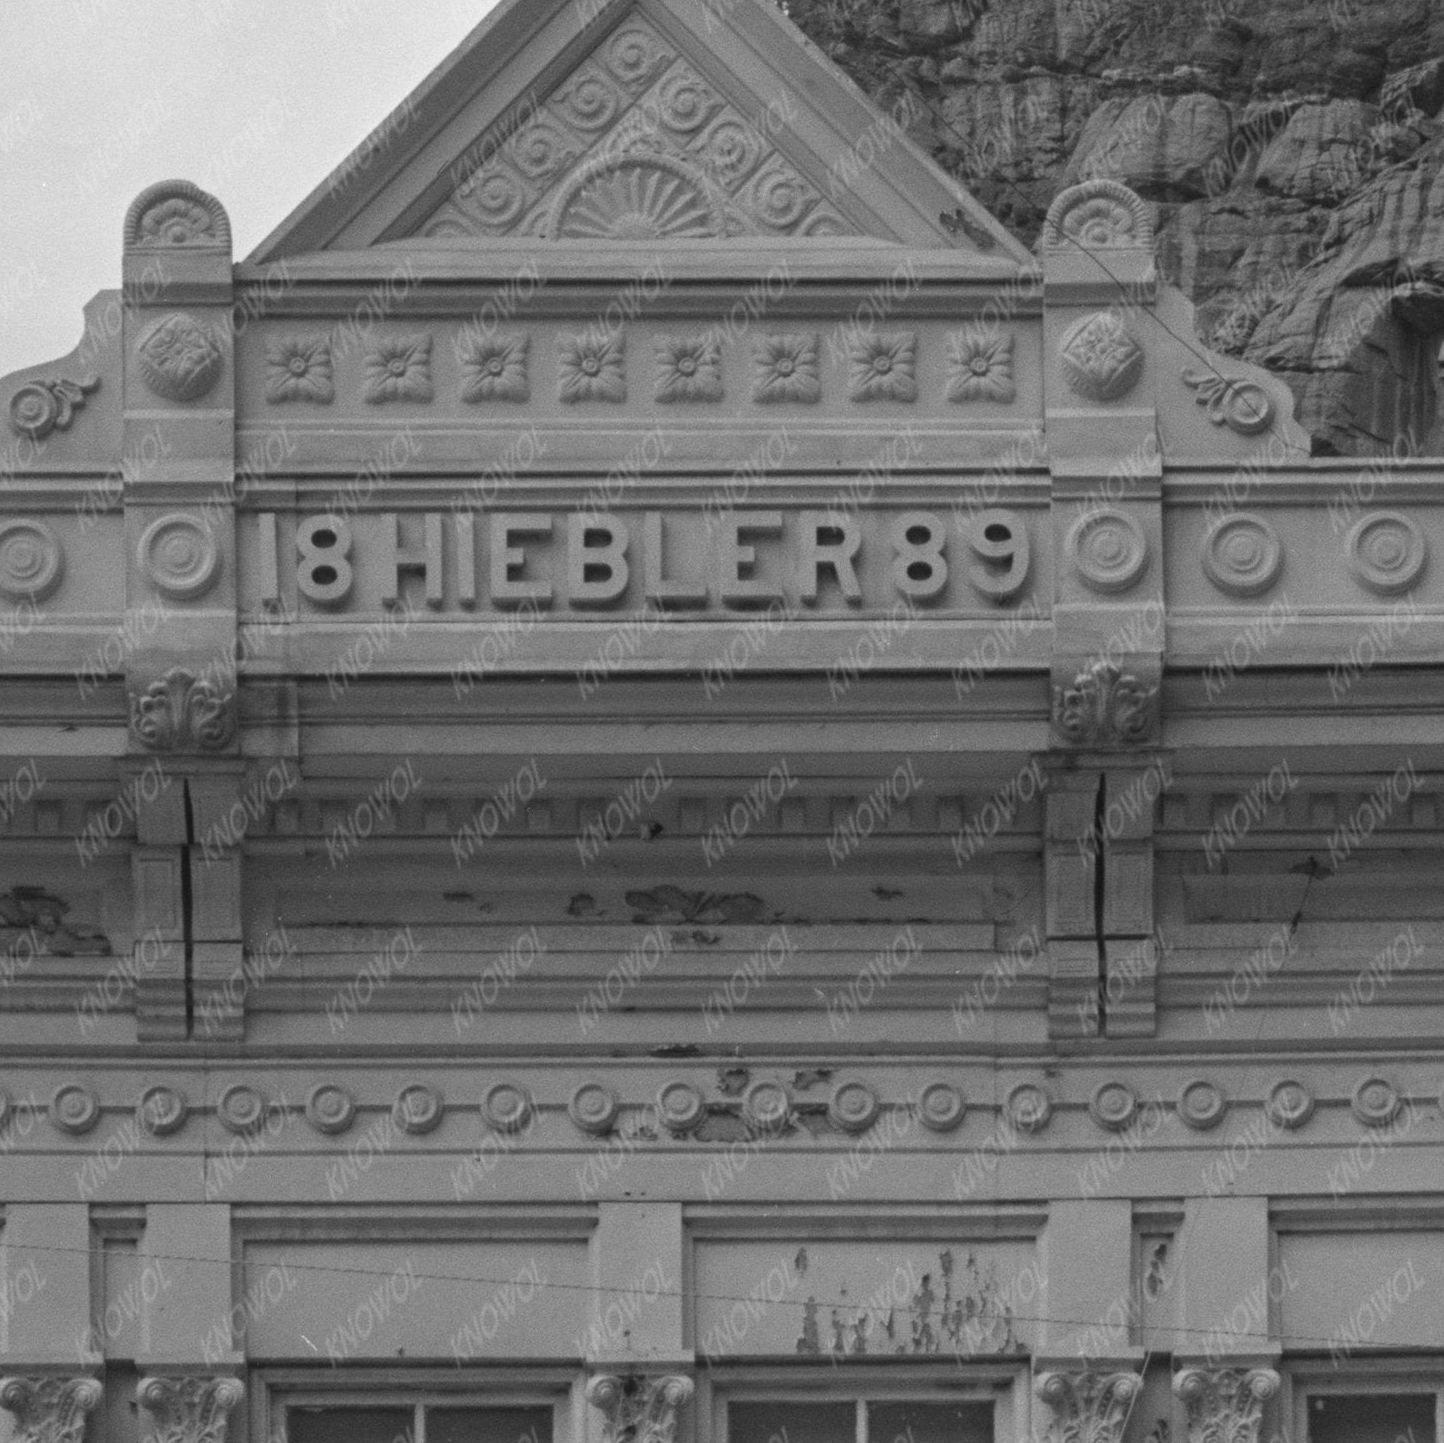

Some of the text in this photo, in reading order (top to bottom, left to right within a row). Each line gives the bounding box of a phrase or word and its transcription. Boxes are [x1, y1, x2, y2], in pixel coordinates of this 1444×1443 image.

[257, 508, 1032, 611] 18 HIEBLER 89
